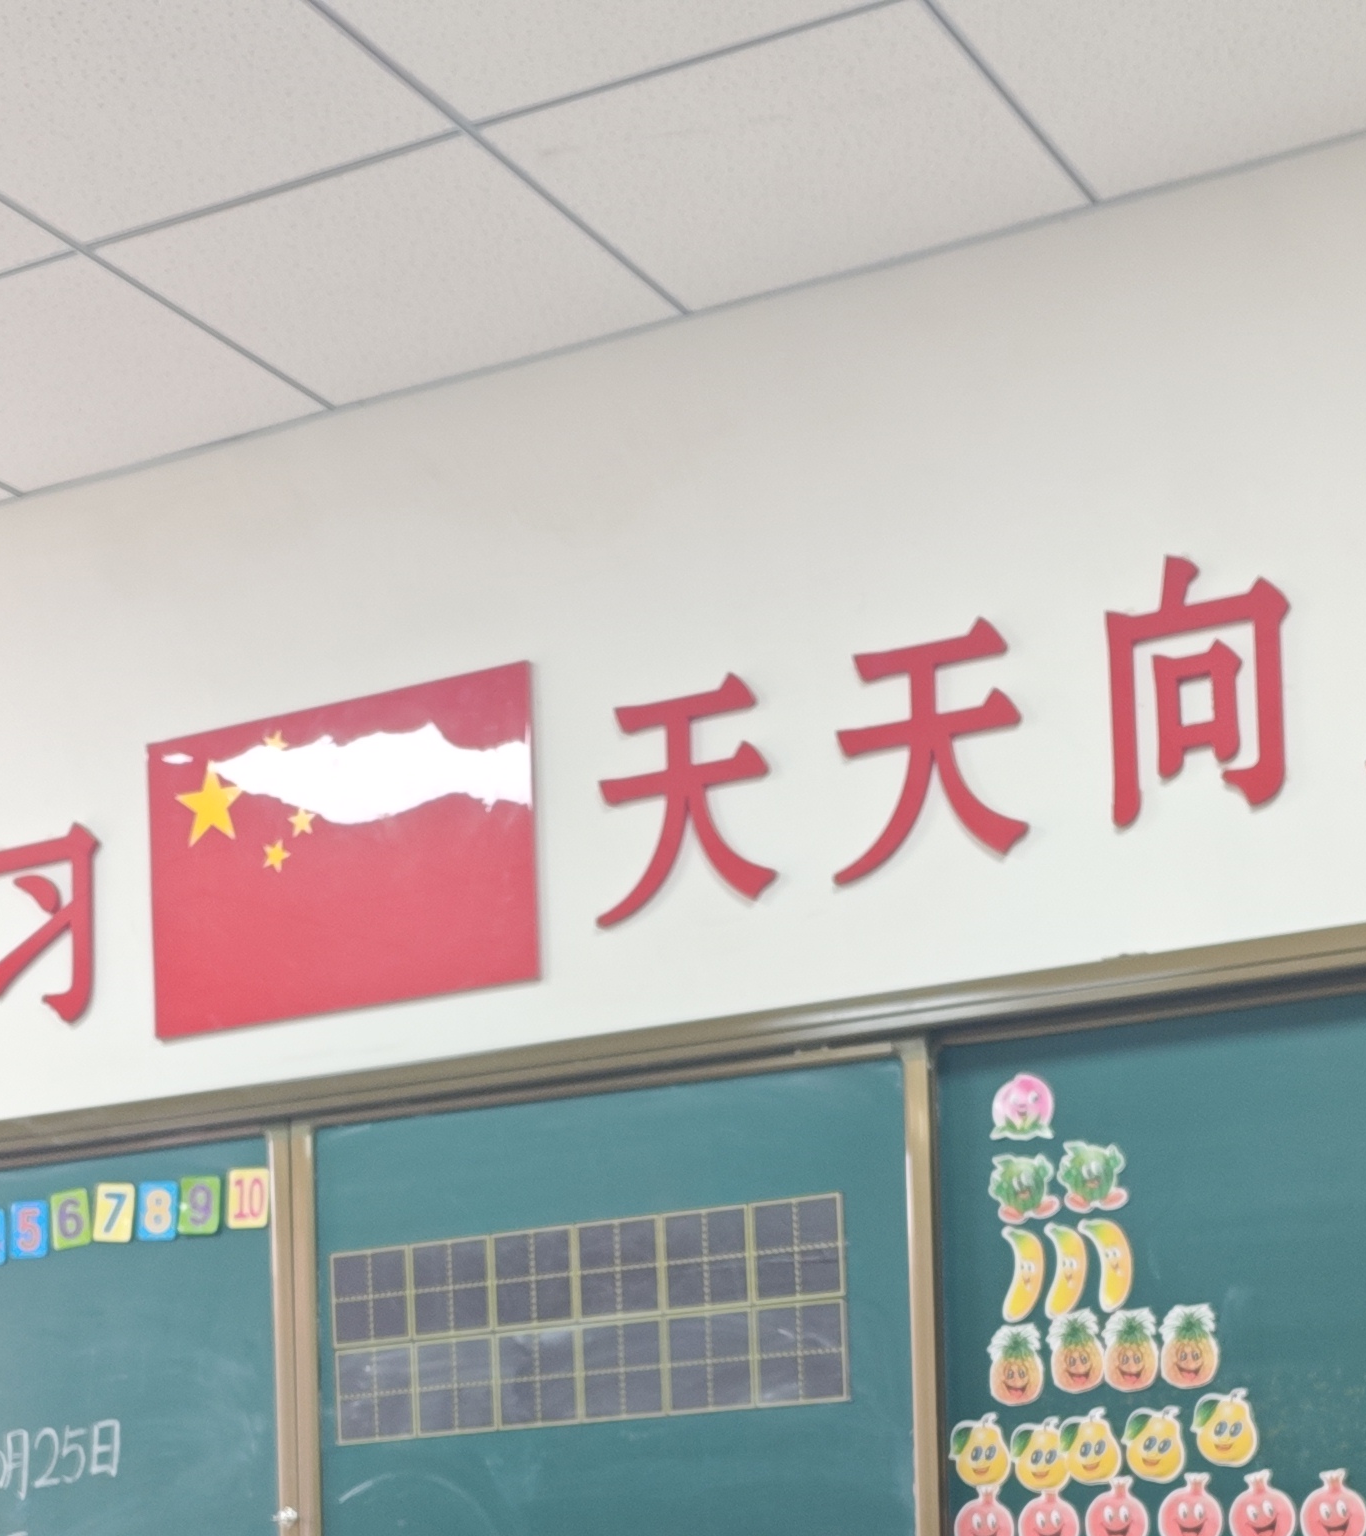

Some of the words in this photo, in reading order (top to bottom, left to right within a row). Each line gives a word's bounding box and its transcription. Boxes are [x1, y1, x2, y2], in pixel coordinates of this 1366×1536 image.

[17, 1207, 41, 1250] 5
[57, 1198, 84, 1240] 6
[103, 1191, 128, 1234] 7
[144, 1187, 172, 1234] 8
[188, 1183, 213, 1227] 9
[233, 1176, 265, 1220] 10
